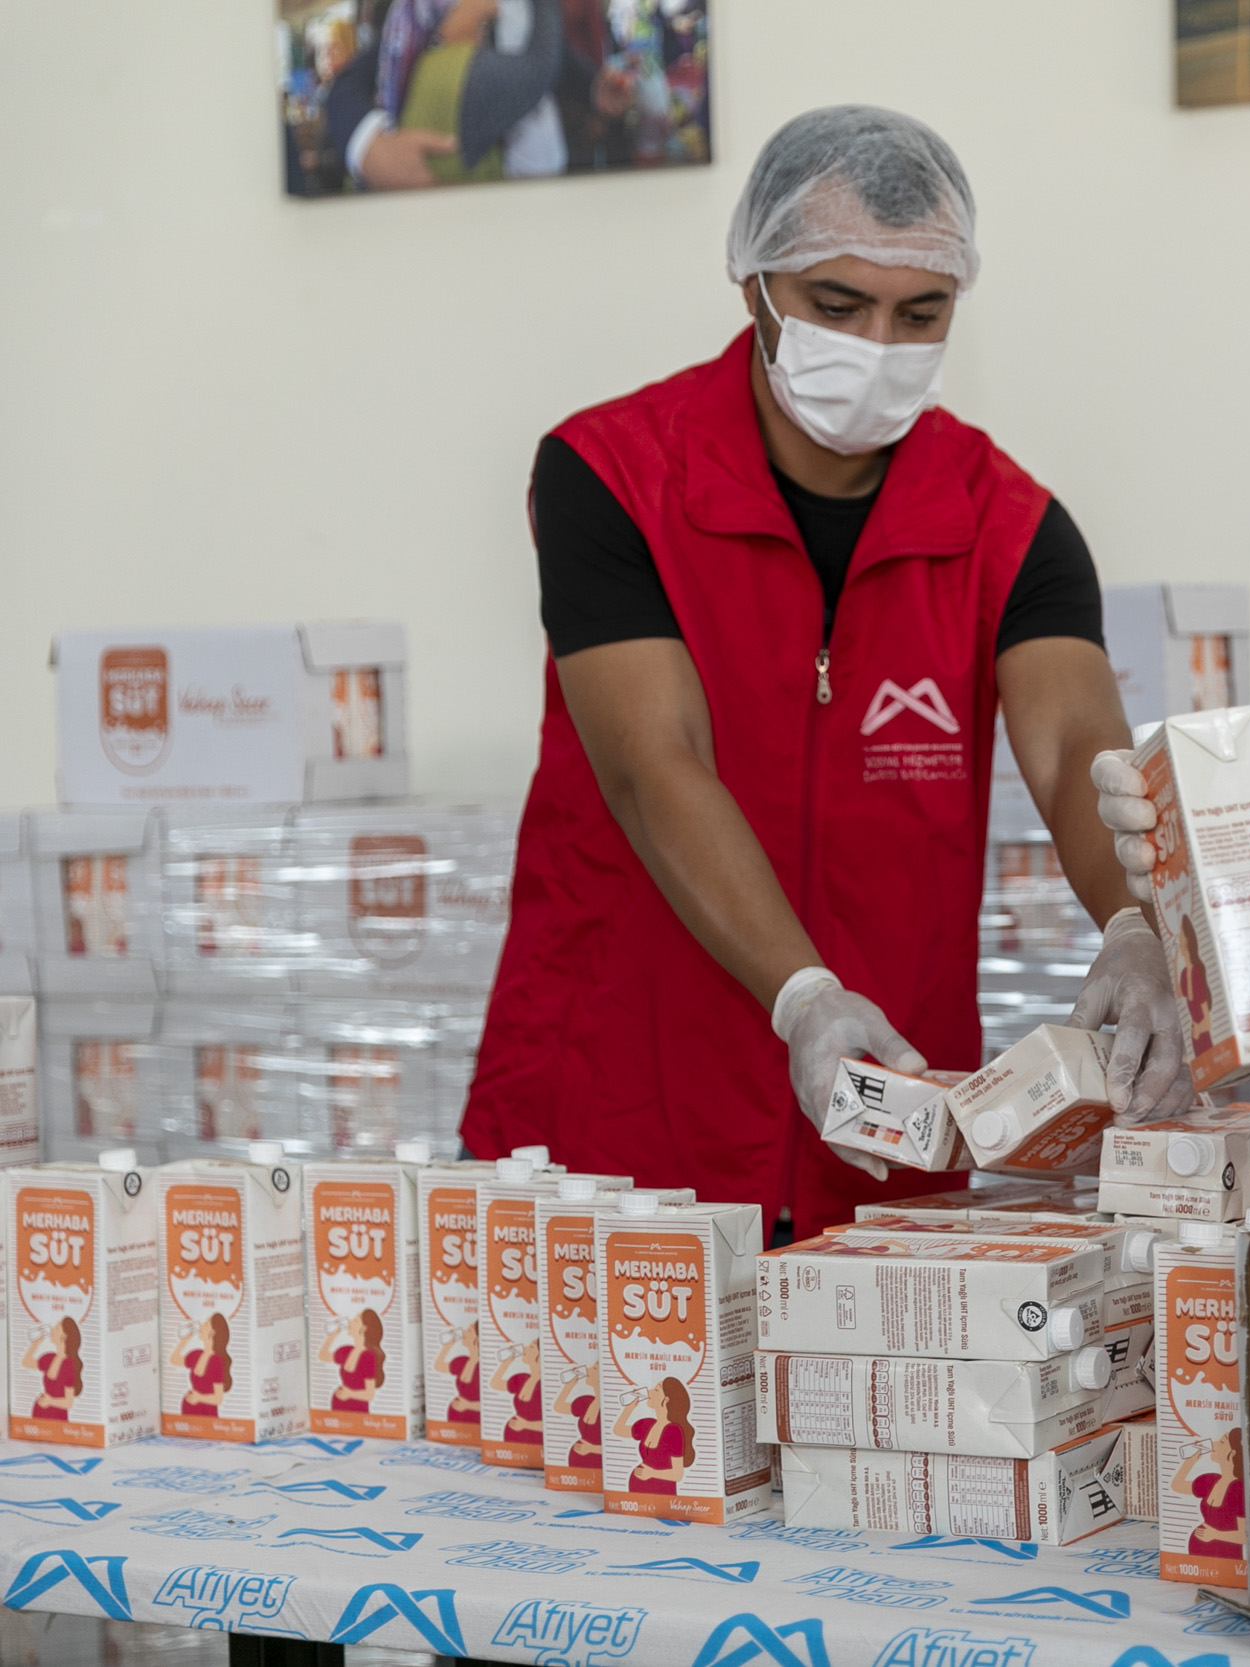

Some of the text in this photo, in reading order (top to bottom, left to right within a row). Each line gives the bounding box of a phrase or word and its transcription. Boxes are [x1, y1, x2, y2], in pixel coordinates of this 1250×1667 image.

[173, 1209, 238, 1228] MERHABA
[320, 1206, 390, 1224] MERHABA
[1175, 1205, 1193, 1214] 1000
[22, 1212, 90, 1232] MERHABA
[434, 1213, 476, 1230] MERH
[29, 1230, 85, 1267] SÜT
[180, 1228, 234, 1263] SÜT
[327, 1224, 386, 1260] SÜT
[442, 1232, 478, 1268] SÜ
[614, 1260, 698, 1281] MERHABA
[780, 1277, 789, 1300] 1000
[623, 1281, 692, 1322] SÜT
[1175, 1297, 1235, 1319] MERH
[1185, 1321, 1238, 1365] SÜ
[760, 1372, 768, 1393] 1000
[495, 1450, 512, 1460] 1000
[560, 1475, 577, 1486] 1000
[620, 1501, 638, 1512] 1000
[734, 1500, 748, 1512] 1000
[1038, 1504, 1047, 1525] 1000
[456, 1553, 576, 1571] Olsun
[1179, 1564, 1199, 1576] 1000
[166, 1567, 286, 1614] Afiyet
[504, 1602, 638, 1656] Afiyet
